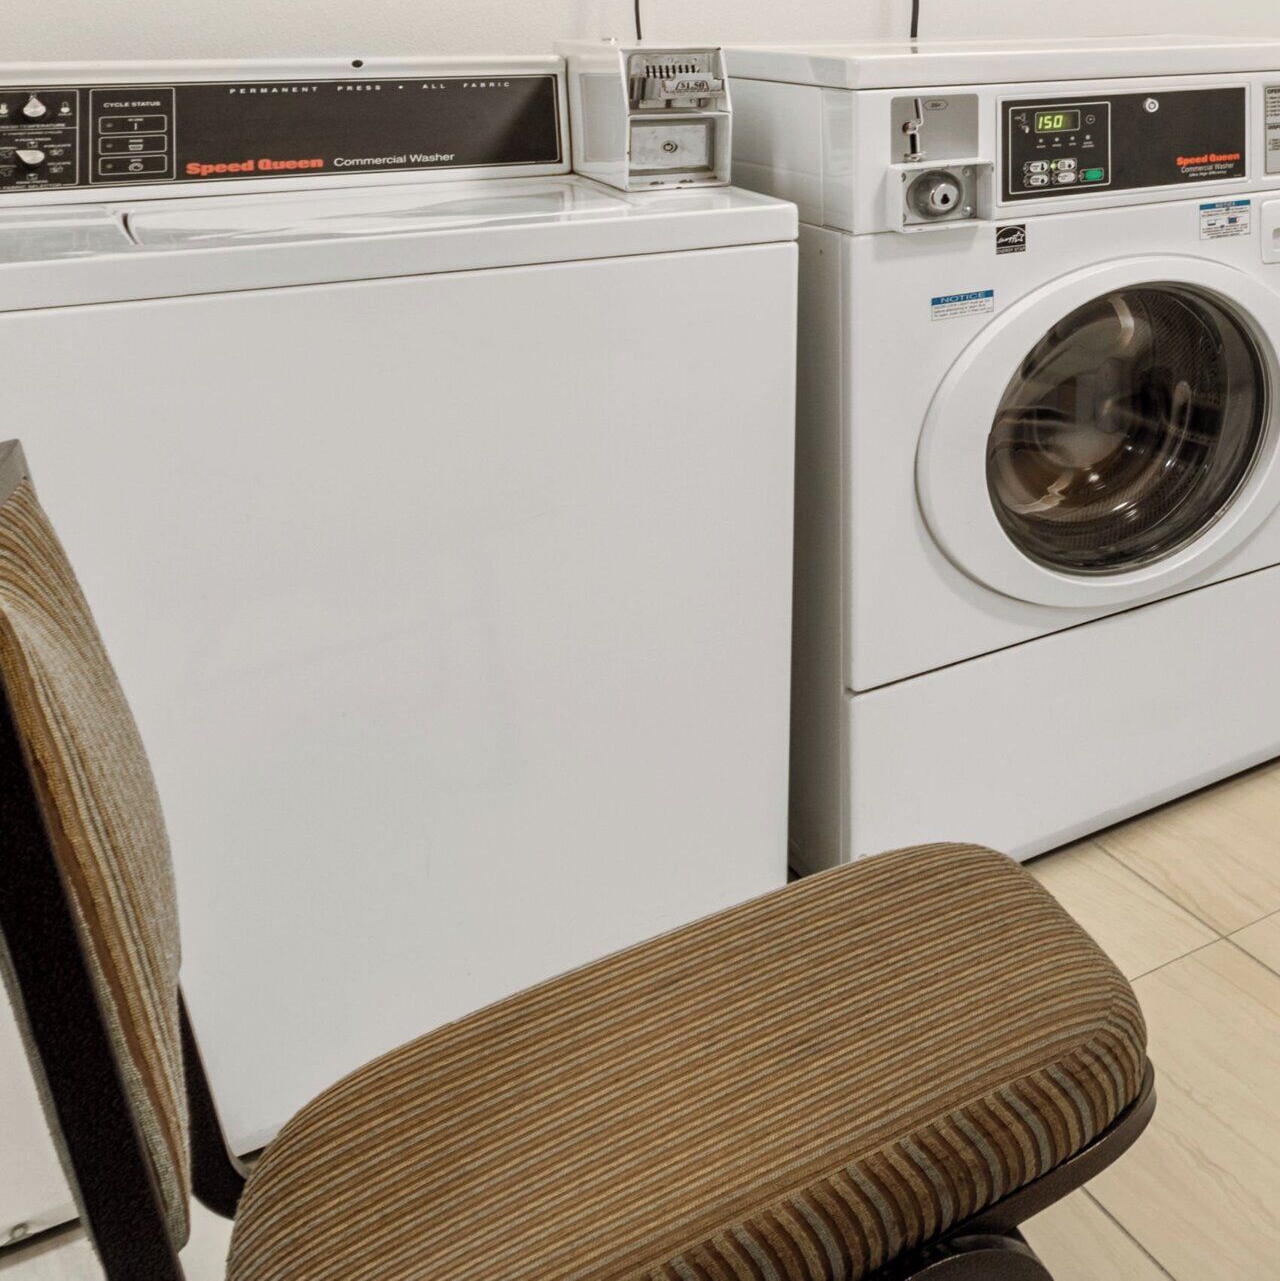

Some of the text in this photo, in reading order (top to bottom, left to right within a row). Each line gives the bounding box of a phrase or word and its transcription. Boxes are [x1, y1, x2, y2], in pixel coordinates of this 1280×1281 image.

[229, 85, 319, 94] PERMANENT
[337, 84, 382, 92] PRESS
[1038, 114, 1064, 129] 150
[186, 152, 455, 176] Speed Queen Commercial Washer
[1176, 152, 1240, 166] Speed Queen
[1181, 162, 1235, 174] Commercial Washer
[940, 292, 985, 304] NOTICE
